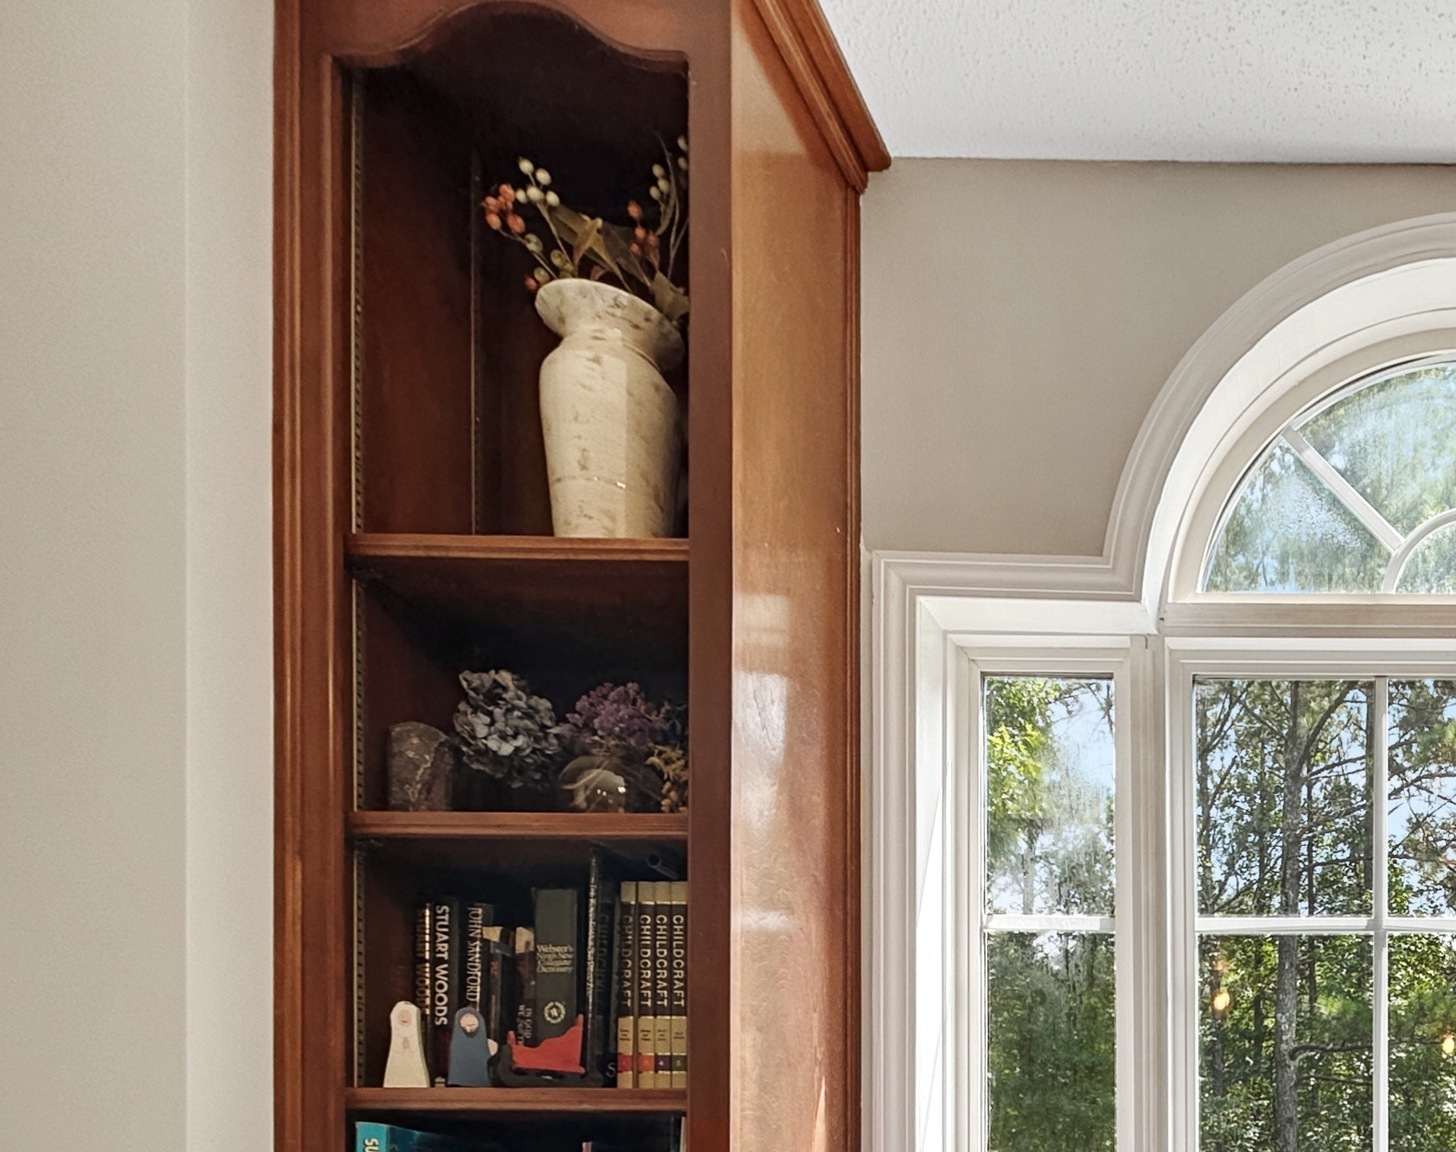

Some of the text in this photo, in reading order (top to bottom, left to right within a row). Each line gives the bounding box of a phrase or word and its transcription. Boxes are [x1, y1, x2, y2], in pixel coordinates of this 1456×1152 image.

[434, 905, 450, 1026] STUART WOODS
[466, 906, 482, 1002] JOHN SANDFORD
[535, 943, 574, 953] Webster's
[536, 965, 574, 974] Dictionary
[640, 914, 652, 1008] CHILDCRAFT
[656, 914, 668, 1008] CHILDCRAFT
[673, 914, 685, 1008] CHILDCRAFT
